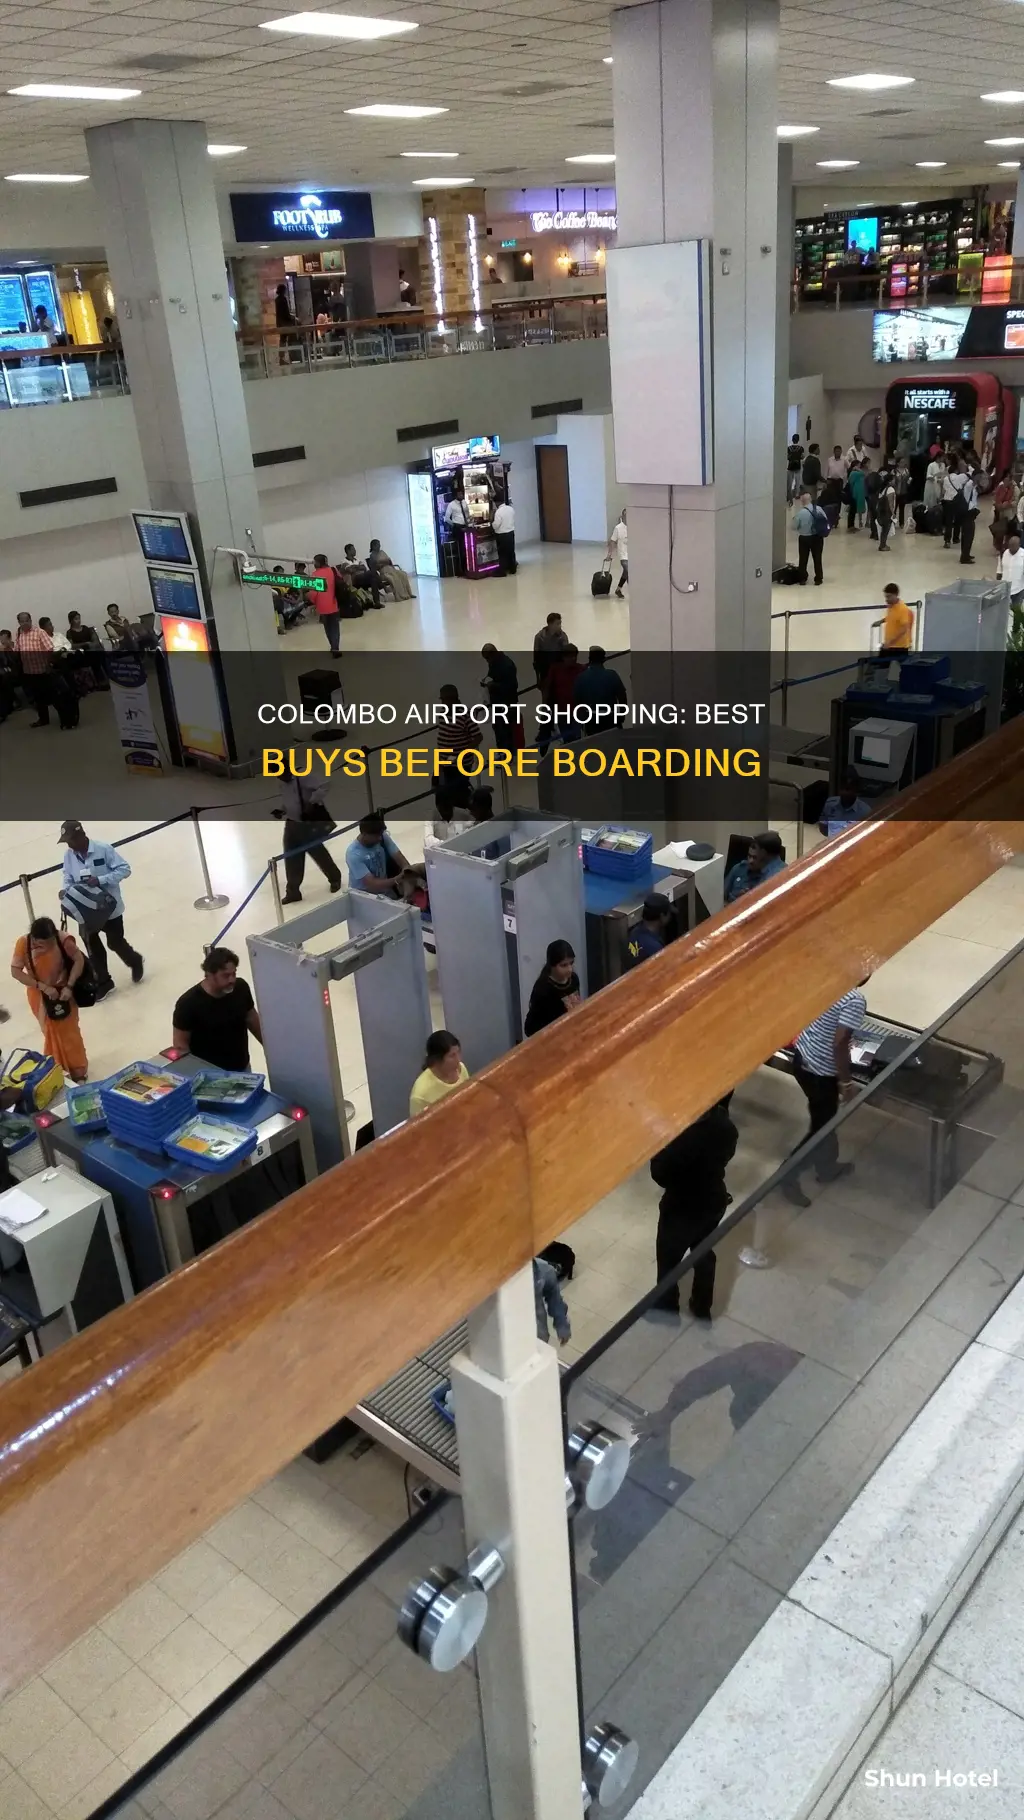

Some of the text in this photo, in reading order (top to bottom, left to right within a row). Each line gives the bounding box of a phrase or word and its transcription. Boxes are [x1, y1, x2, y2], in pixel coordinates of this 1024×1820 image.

[272, 210, 308, 225] FOOT
[530, 211, 553, 233] The
[552, 211, 586, 229] Coffee
[282, 224, 315, 232] WELLNESS
[507, 919, 512, 927] 7
[256, 1146, 263, 1156] 8
